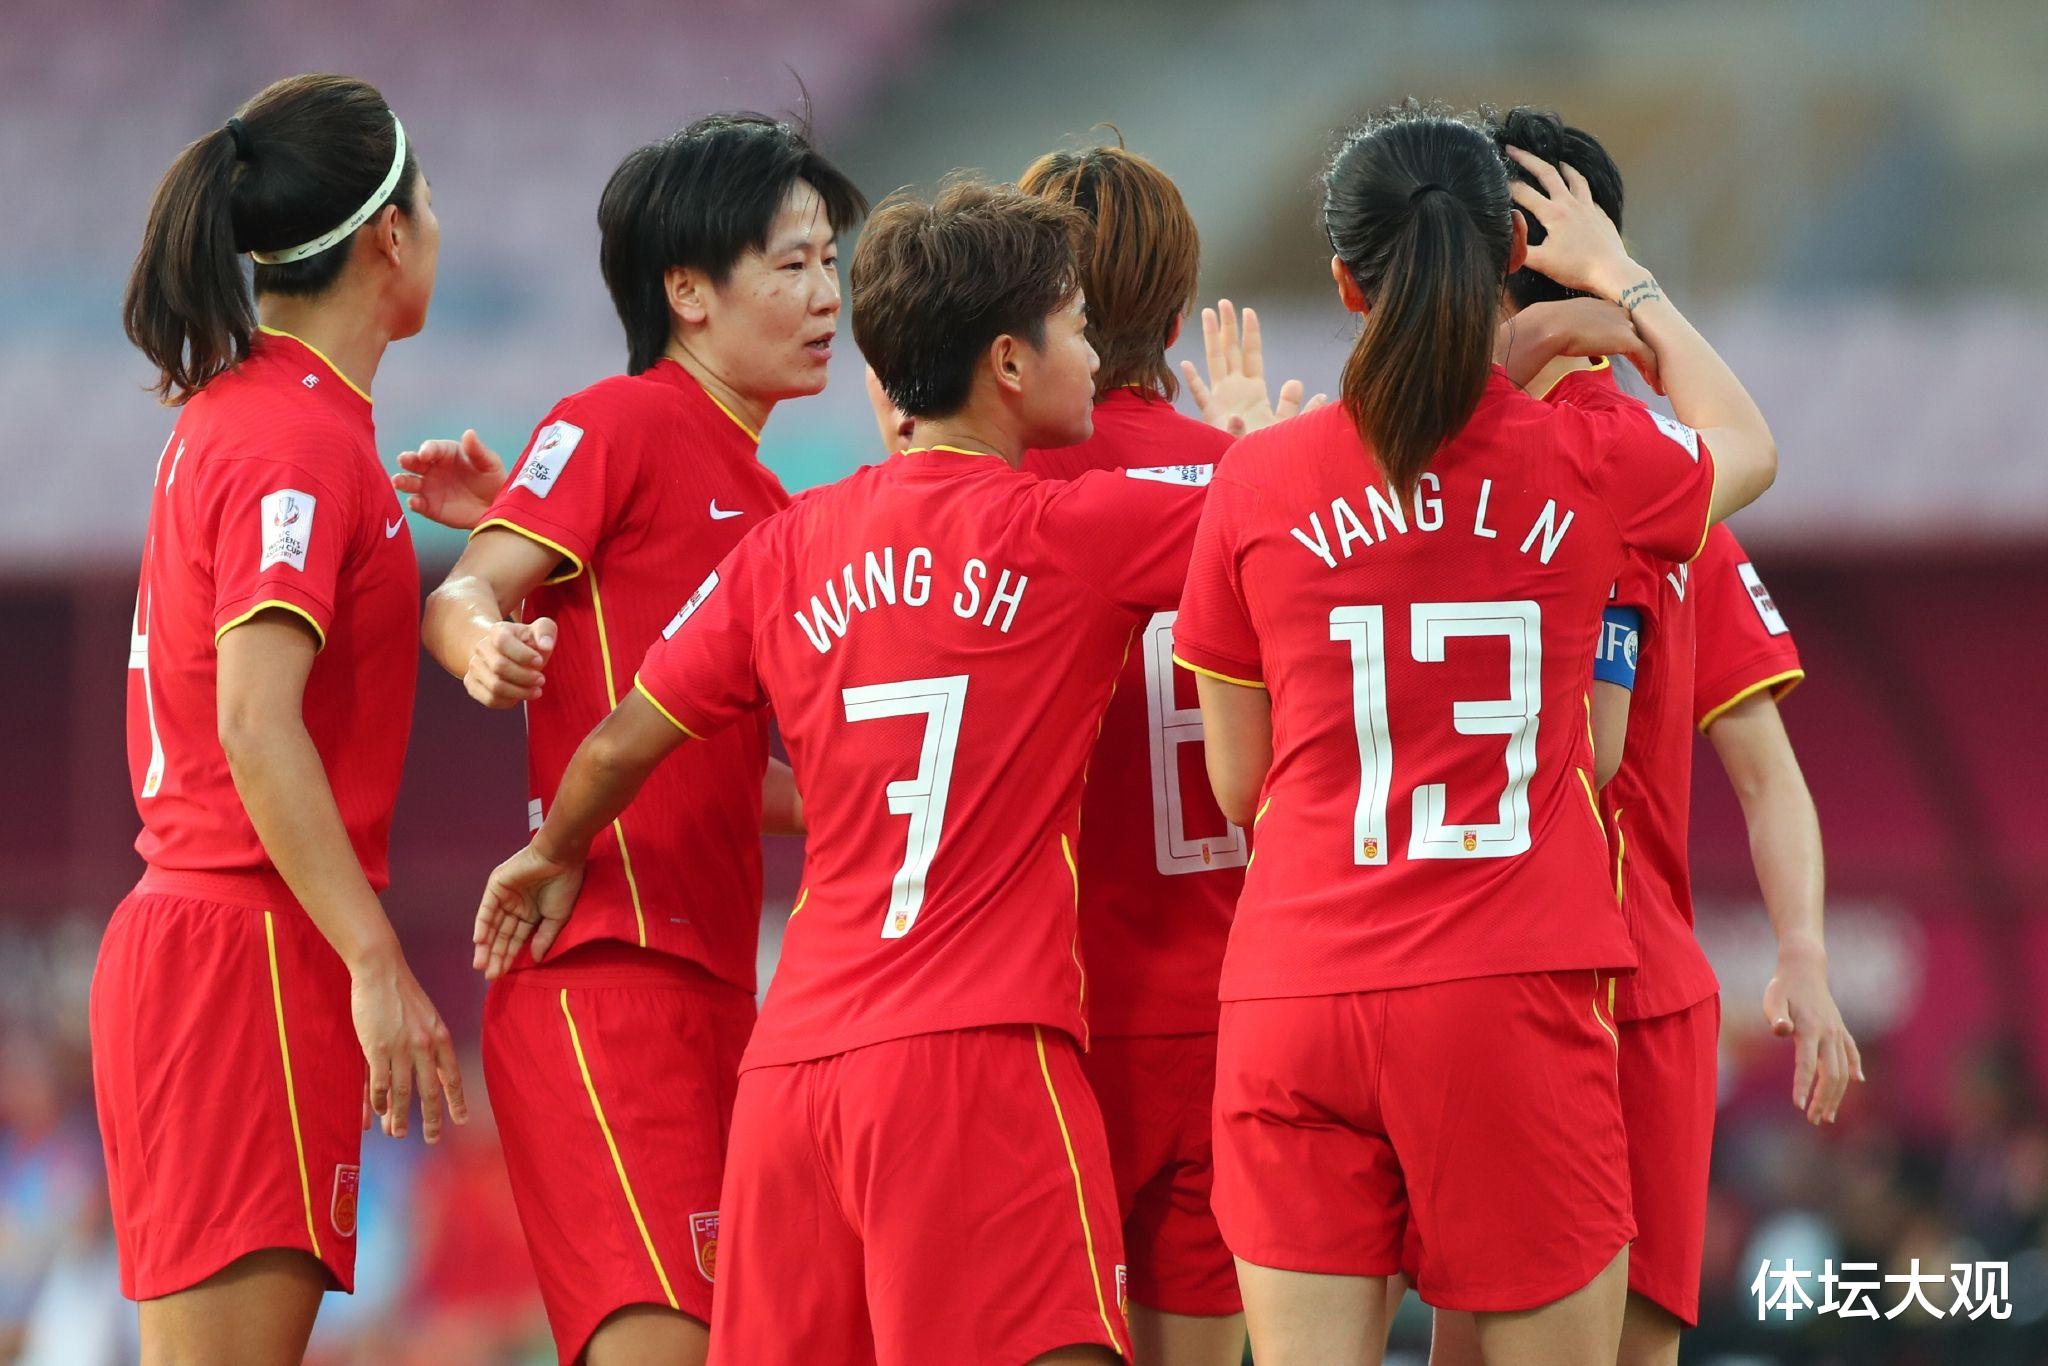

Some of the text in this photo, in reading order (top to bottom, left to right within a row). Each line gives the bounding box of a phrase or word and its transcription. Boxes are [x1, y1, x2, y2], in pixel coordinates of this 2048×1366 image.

[793, 546, 1029, 654] WANG SH
[1289, 471, 1575, 569] YANG L N
[841, 674, 970, 939] 7
[1328, 600, 1542, 865] 13
